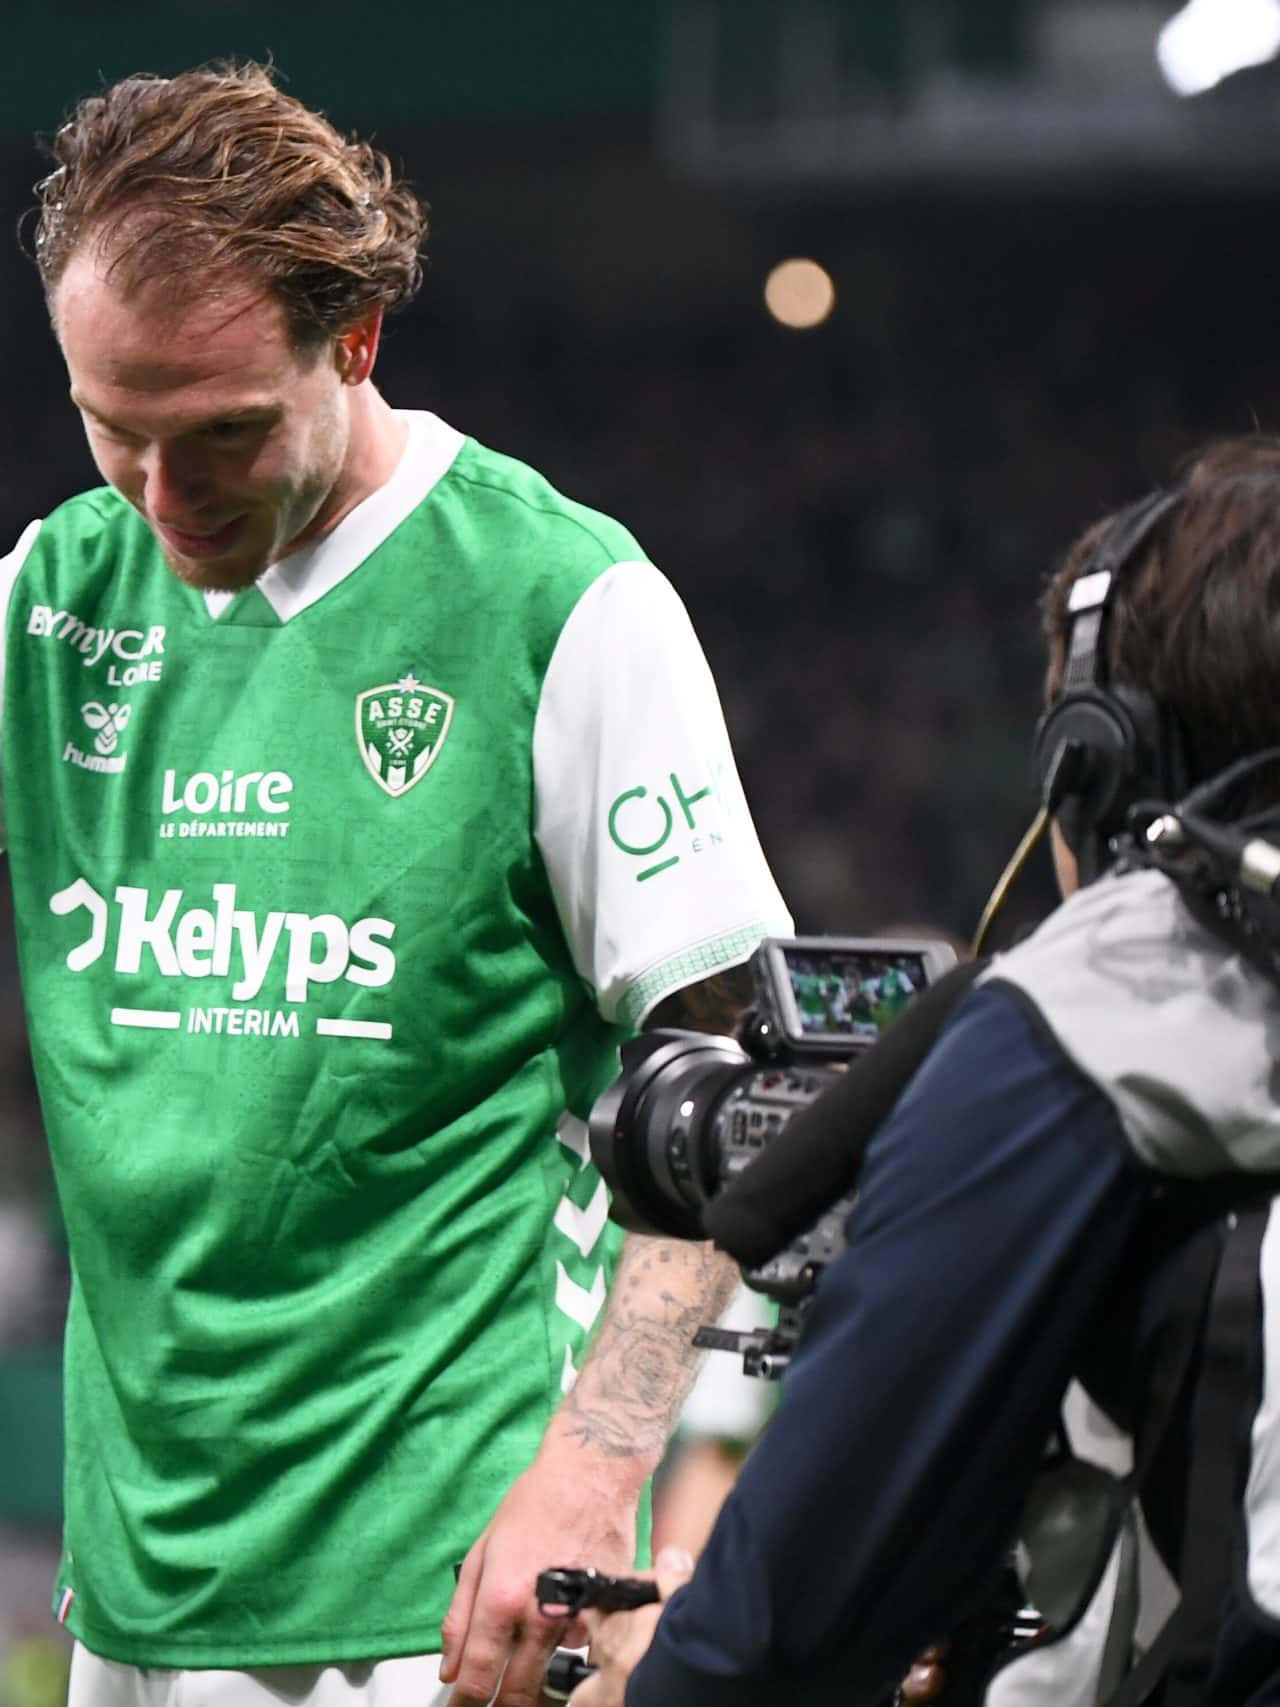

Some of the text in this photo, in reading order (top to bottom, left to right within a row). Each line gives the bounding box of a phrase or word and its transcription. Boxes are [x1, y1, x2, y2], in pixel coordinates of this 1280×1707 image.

[369, 697, 442, 724] ASSE
[160, 819, 289, 838] LE DÉPARTEMENT
[115, 883, 396, 1003] Kelyps
[187, 1007, 300, 1037] INTERIM
